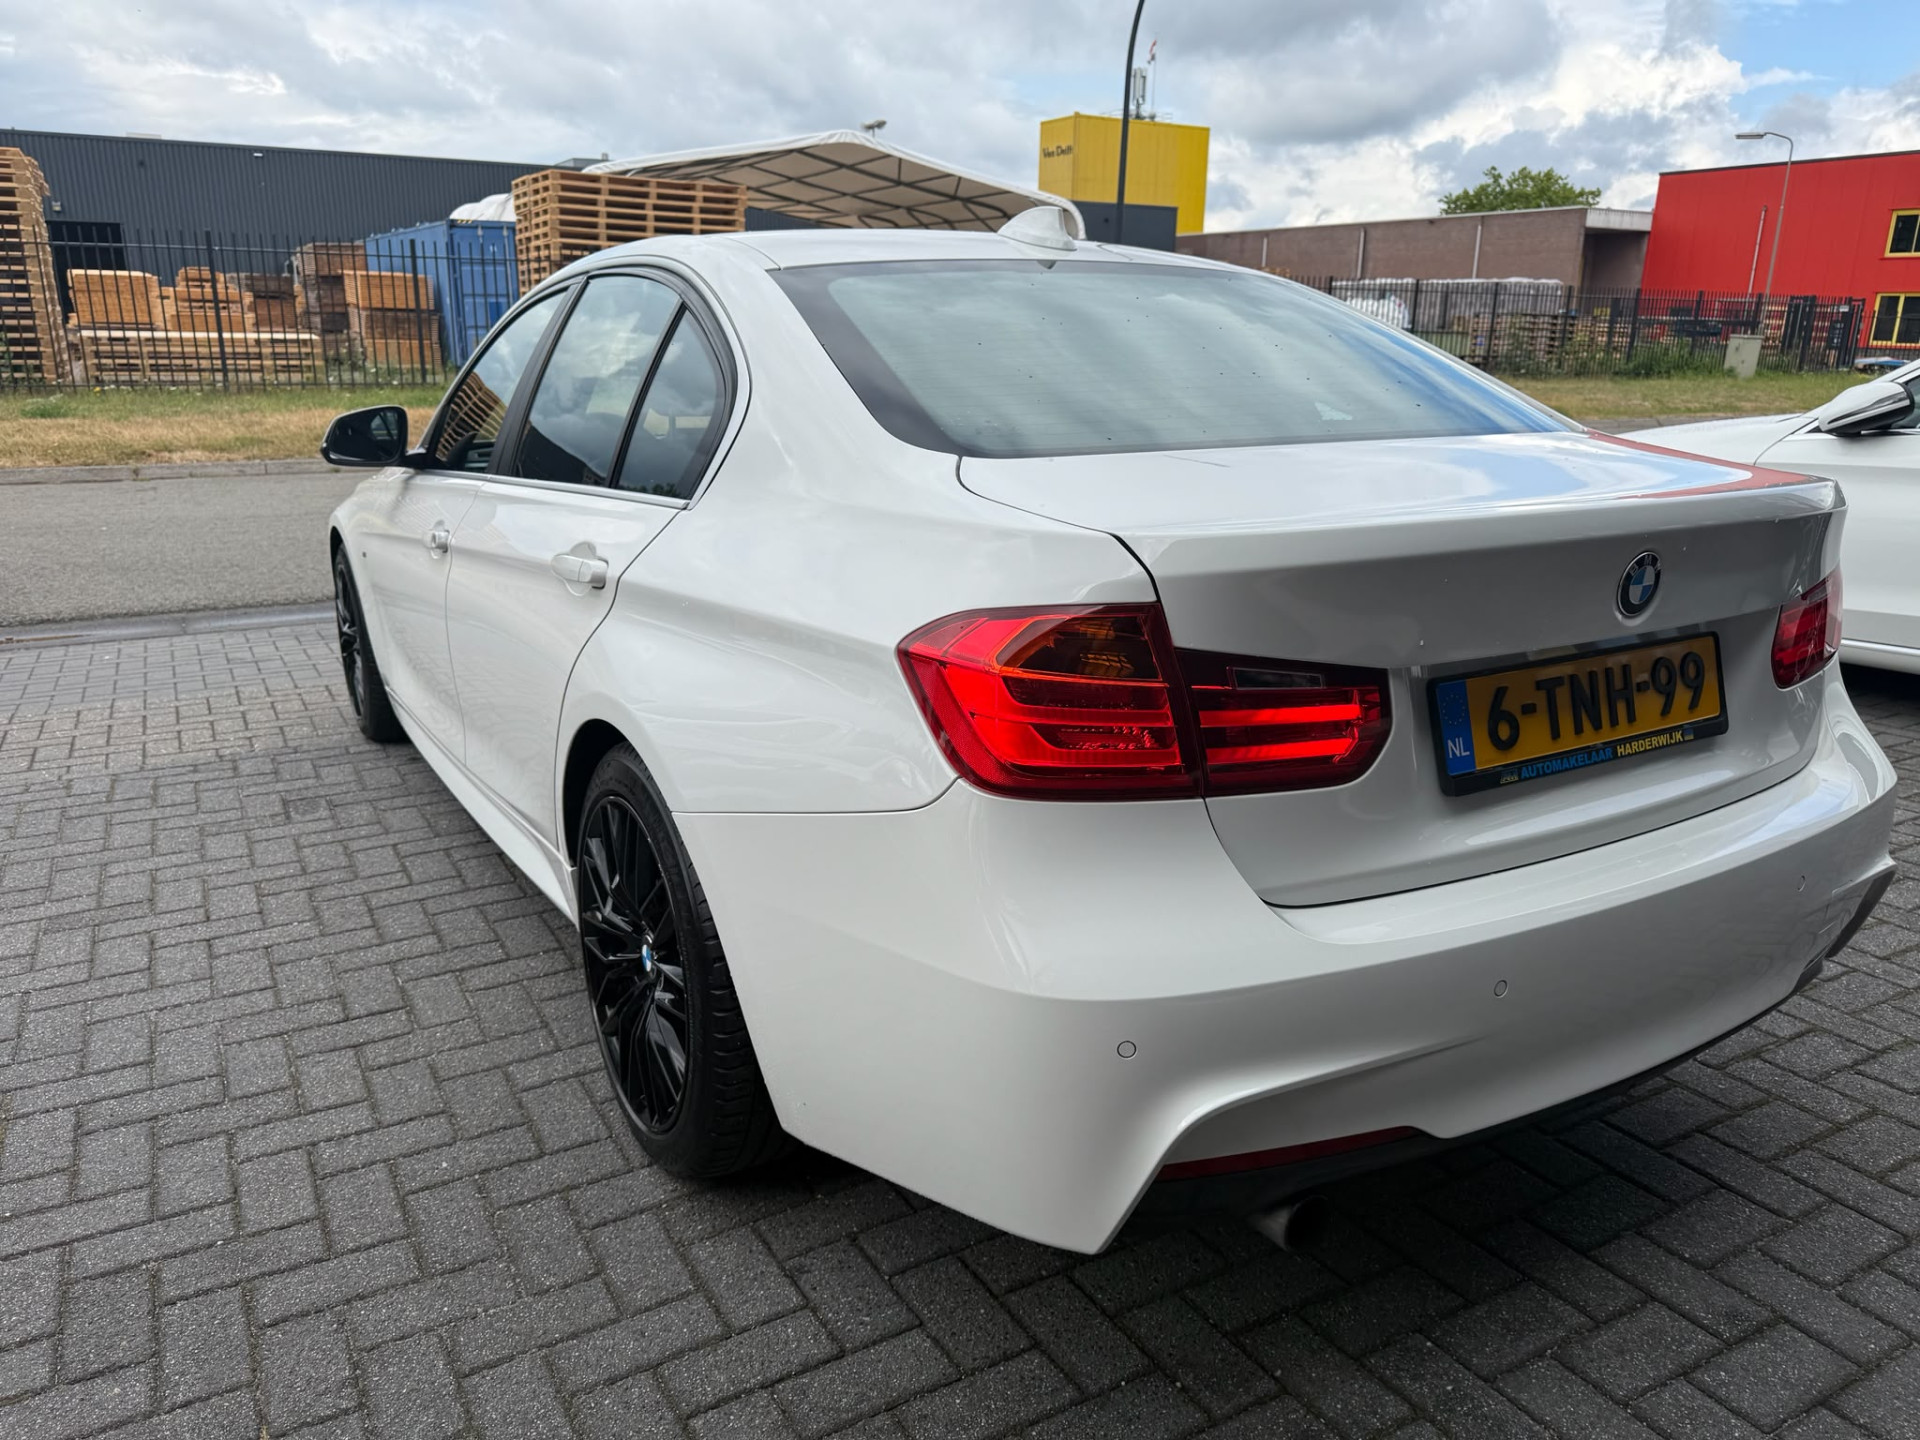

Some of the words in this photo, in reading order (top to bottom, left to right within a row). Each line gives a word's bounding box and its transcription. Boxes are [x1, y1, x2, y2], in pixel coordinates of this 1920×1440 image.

[1628, 554, 1661, 576] BMW
[1487, 651, 1705, 751] 6-TNH-99
[1447, 737, 1470, 758] NL
[1521, 747, 1613, 779] AUTOMAKELAAR
[1617, 730, 1683, 757] HARDERWIJK
